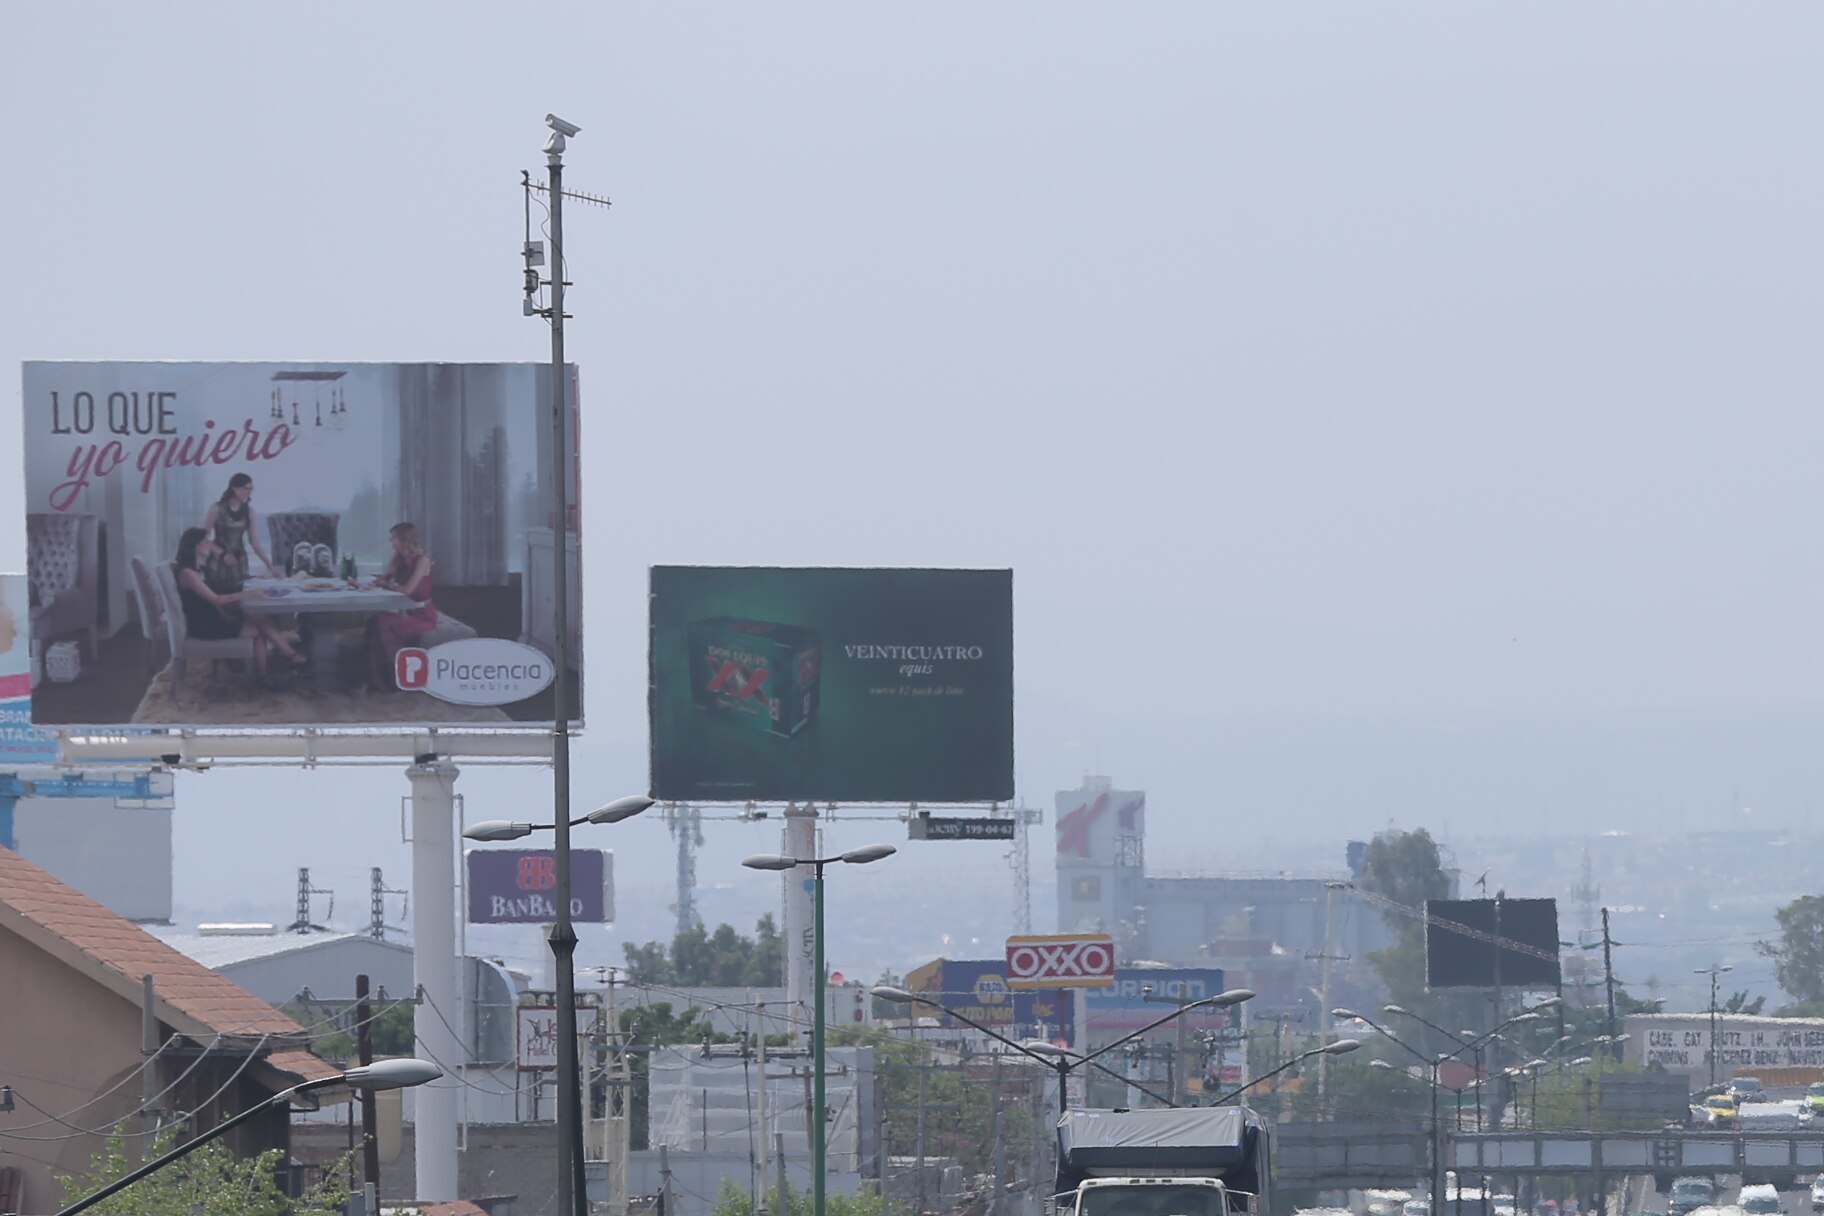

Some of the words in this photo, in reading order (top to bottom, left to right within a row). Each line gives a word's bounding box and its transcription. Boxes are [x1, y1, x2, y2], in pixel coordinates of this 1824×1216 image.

[50, 391, 95, 434] LO
[107, 391, 178, 435] QUE
[49, 440, 128, 512] yo
[136, 419, 298, 494] quiero
[845, 644, 983, 660] VEINTICUATRO
[436, 658, 541, 681] Placencia
[899, 661, 933, 677] equis
[1010, 944, 1109, 977] OXXO
